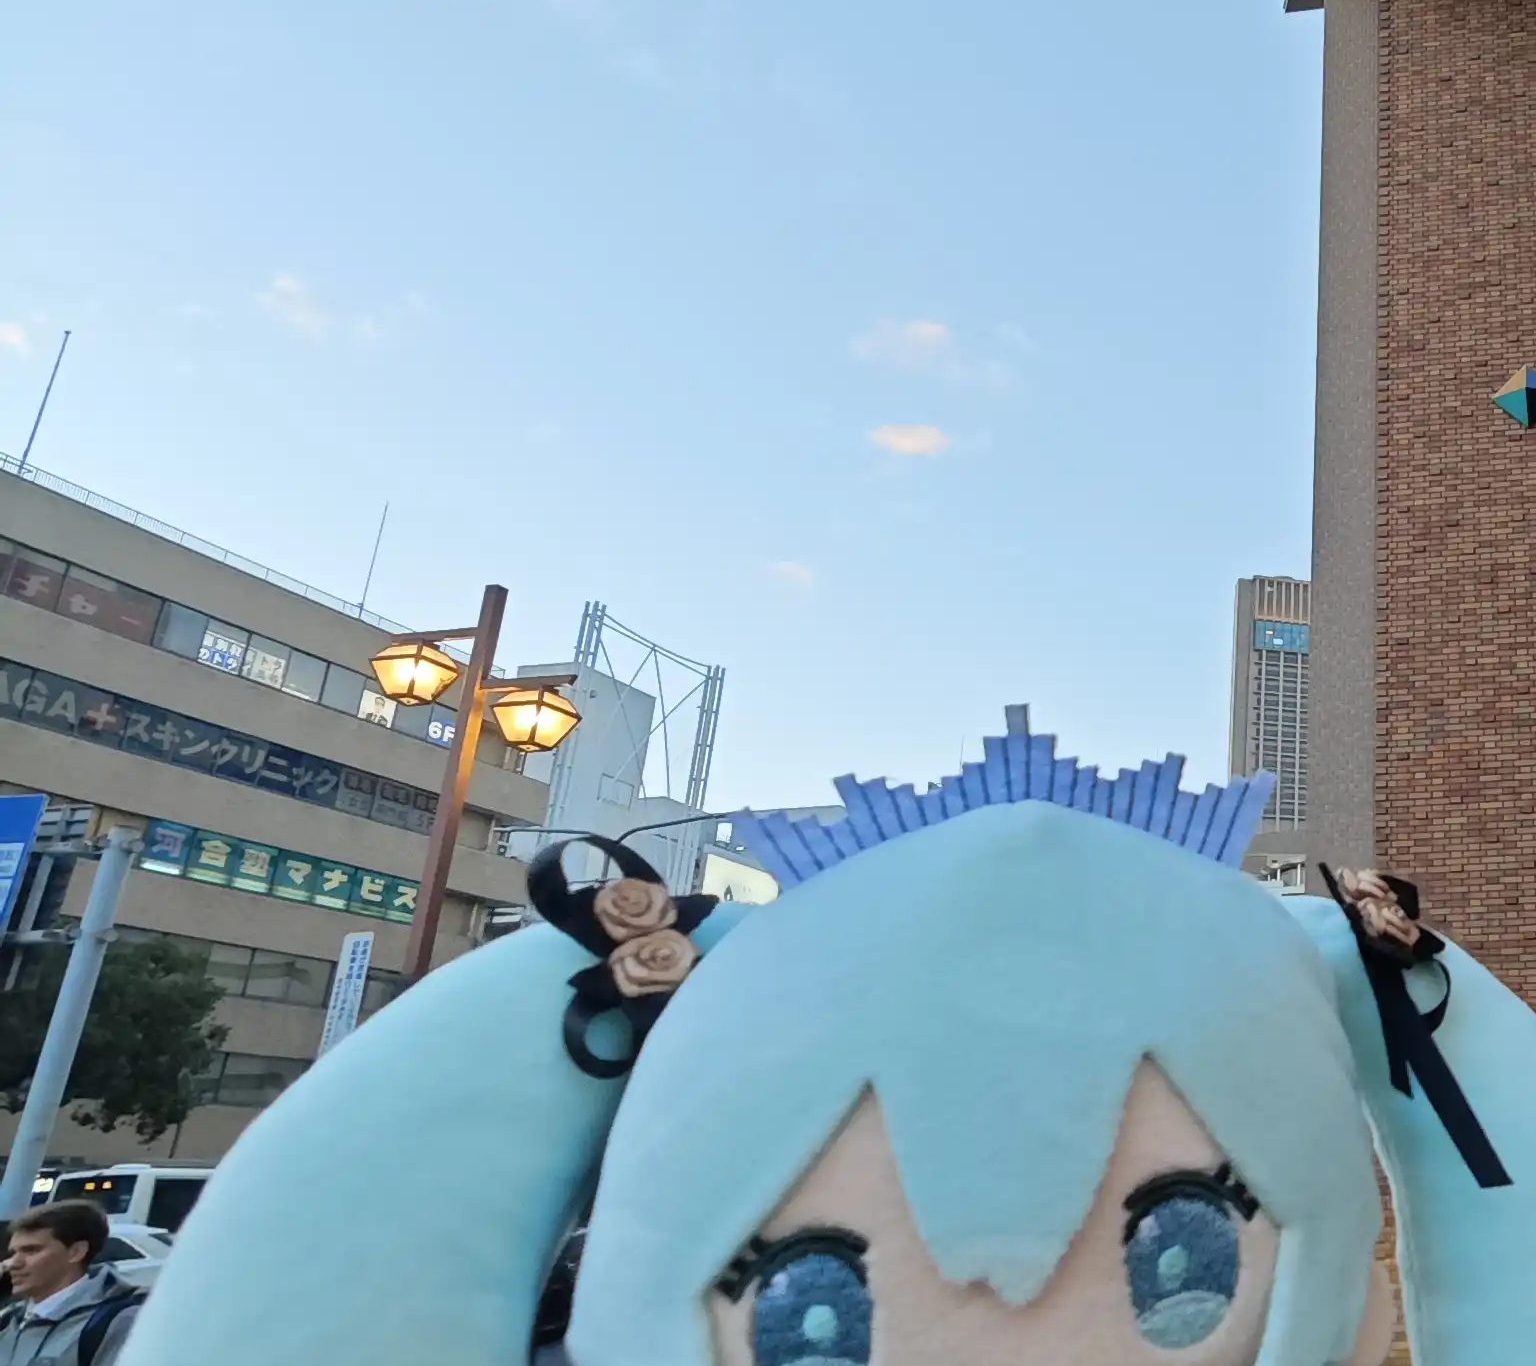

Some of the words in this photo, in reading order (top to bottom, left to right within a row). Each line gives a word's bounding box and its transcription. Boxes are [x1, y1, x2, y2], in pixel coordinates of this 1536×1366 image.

[124, 713, 338, 795] スキンクリニック
[428, 721, 456, 742] 6F
[149, 826, 418, 910] 河合塾マナビス
